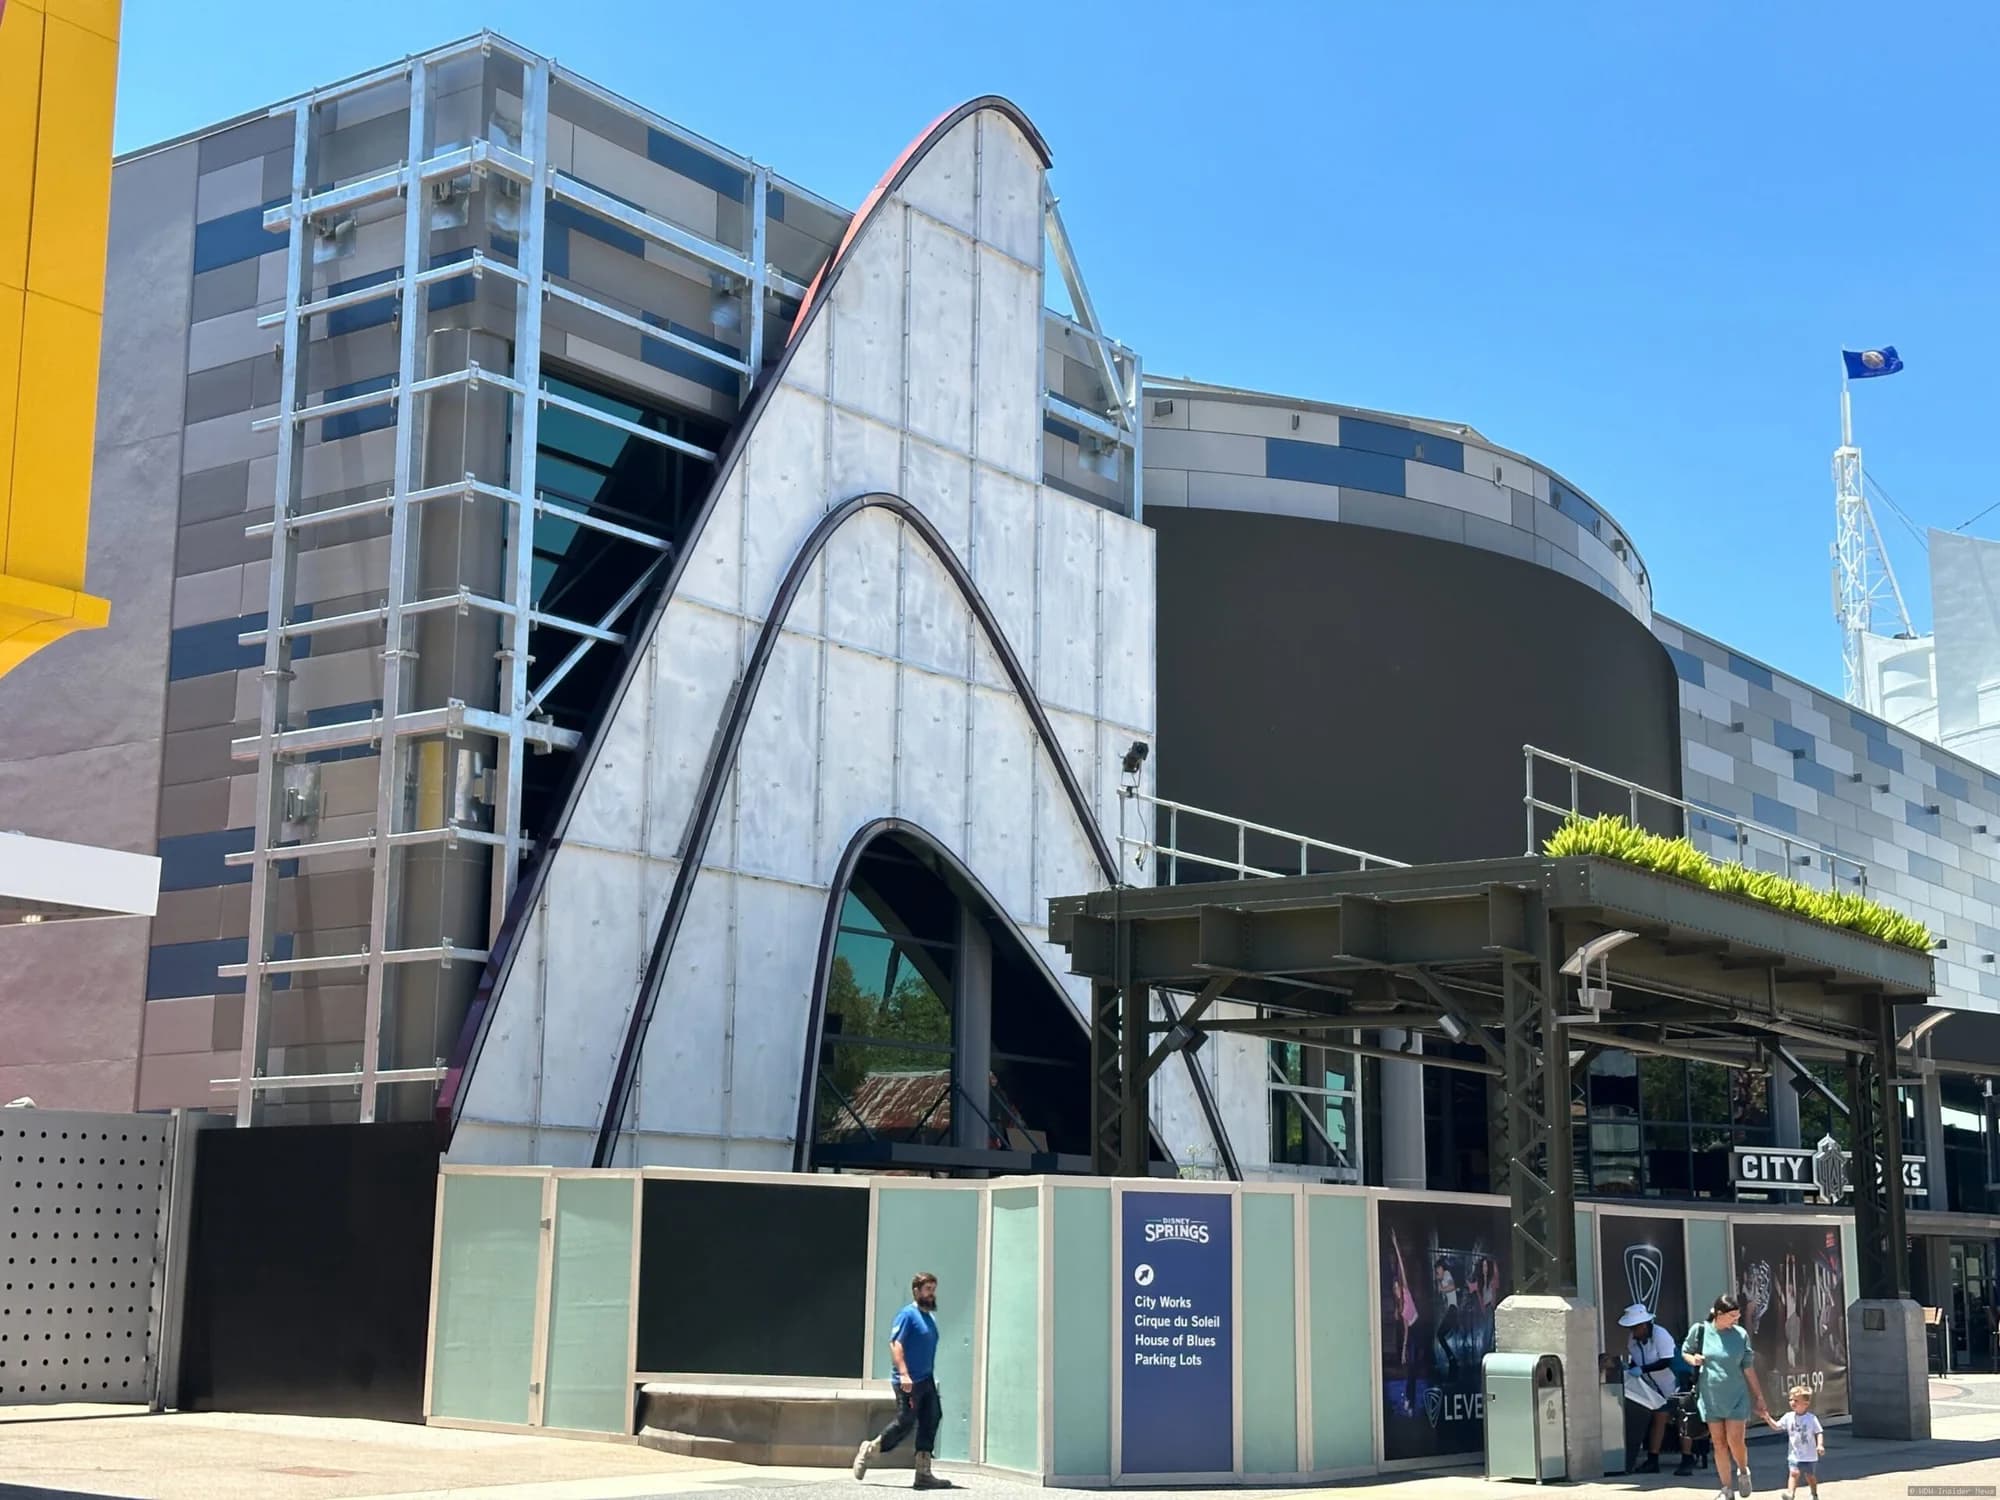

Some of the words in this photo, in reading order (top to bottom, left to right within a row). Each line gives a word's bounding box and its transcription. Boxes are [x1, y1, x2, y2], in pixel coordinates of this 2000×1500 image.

[1742, 1155, 1803, 1180] CITY
[1145, 1224, 1209, 1243] SPRINGS
[1134, 1295, 1157, 1310] City
[1159, 1295, 1192, 1309] Works
[1134, 1314, 1171, 1329] Cirque
[1173, 1315, 1188, 1327] du
[1191, 1315, 1220, 1328] Soleil
[1135, 1334, 1170, 1346] House
[1172, 1334, 1184, 1346] of
[1186, 1334, 1216, 1347] Blues
[1135, 1353, 1177, 1368] Parking
[1179, 1353, 1202, 1366] Lots
